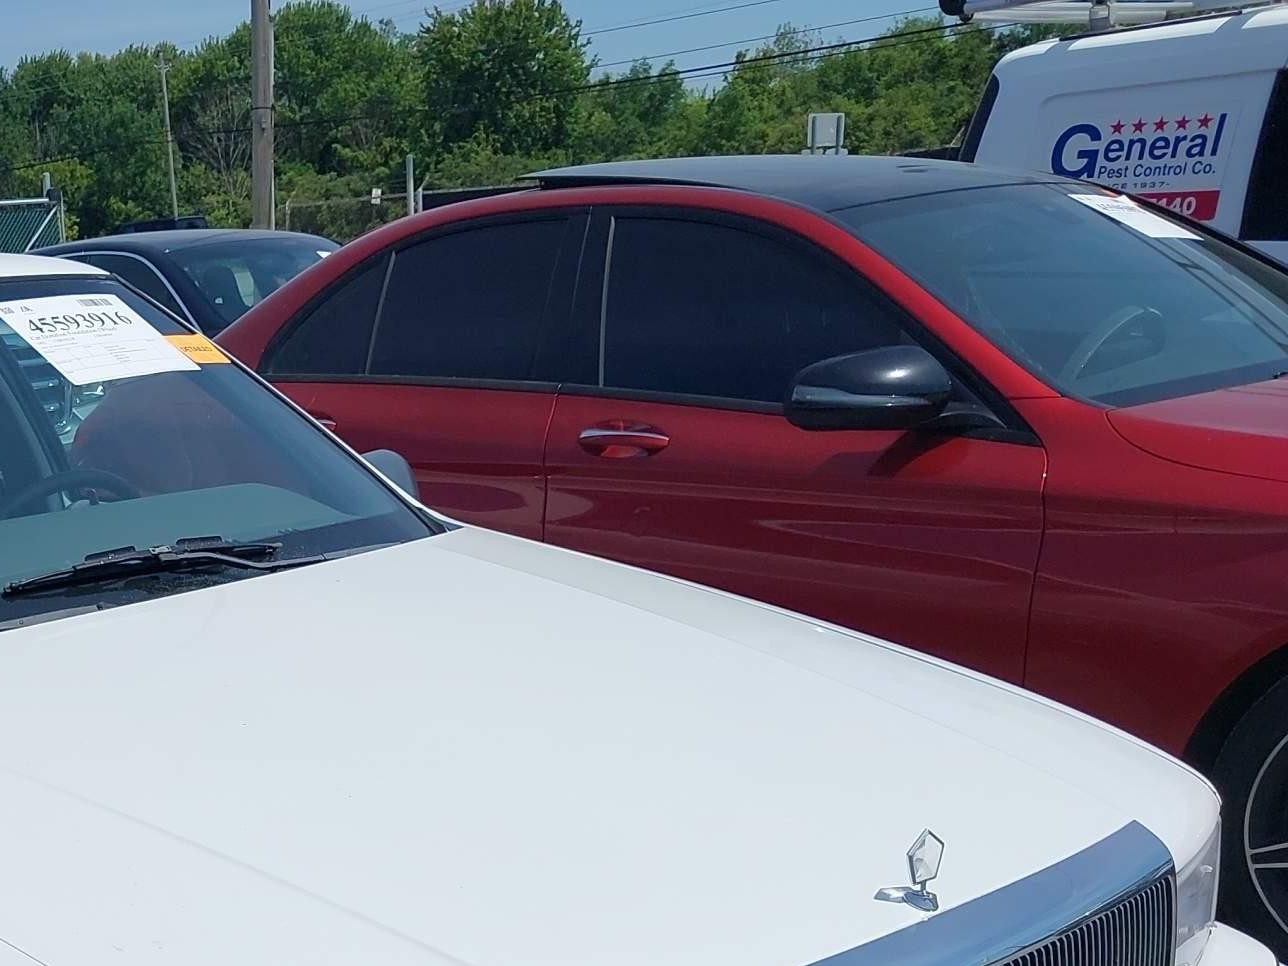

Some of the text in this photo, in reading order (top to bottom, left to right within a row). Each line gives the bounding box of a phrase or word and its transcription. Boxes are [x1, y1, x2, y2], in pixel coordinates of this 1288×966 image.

[1051, 113, 1228, 179] General
[1097, 160, 1216, 179] Pest Control Co.
[28, 312, 133, 334] 45593916
